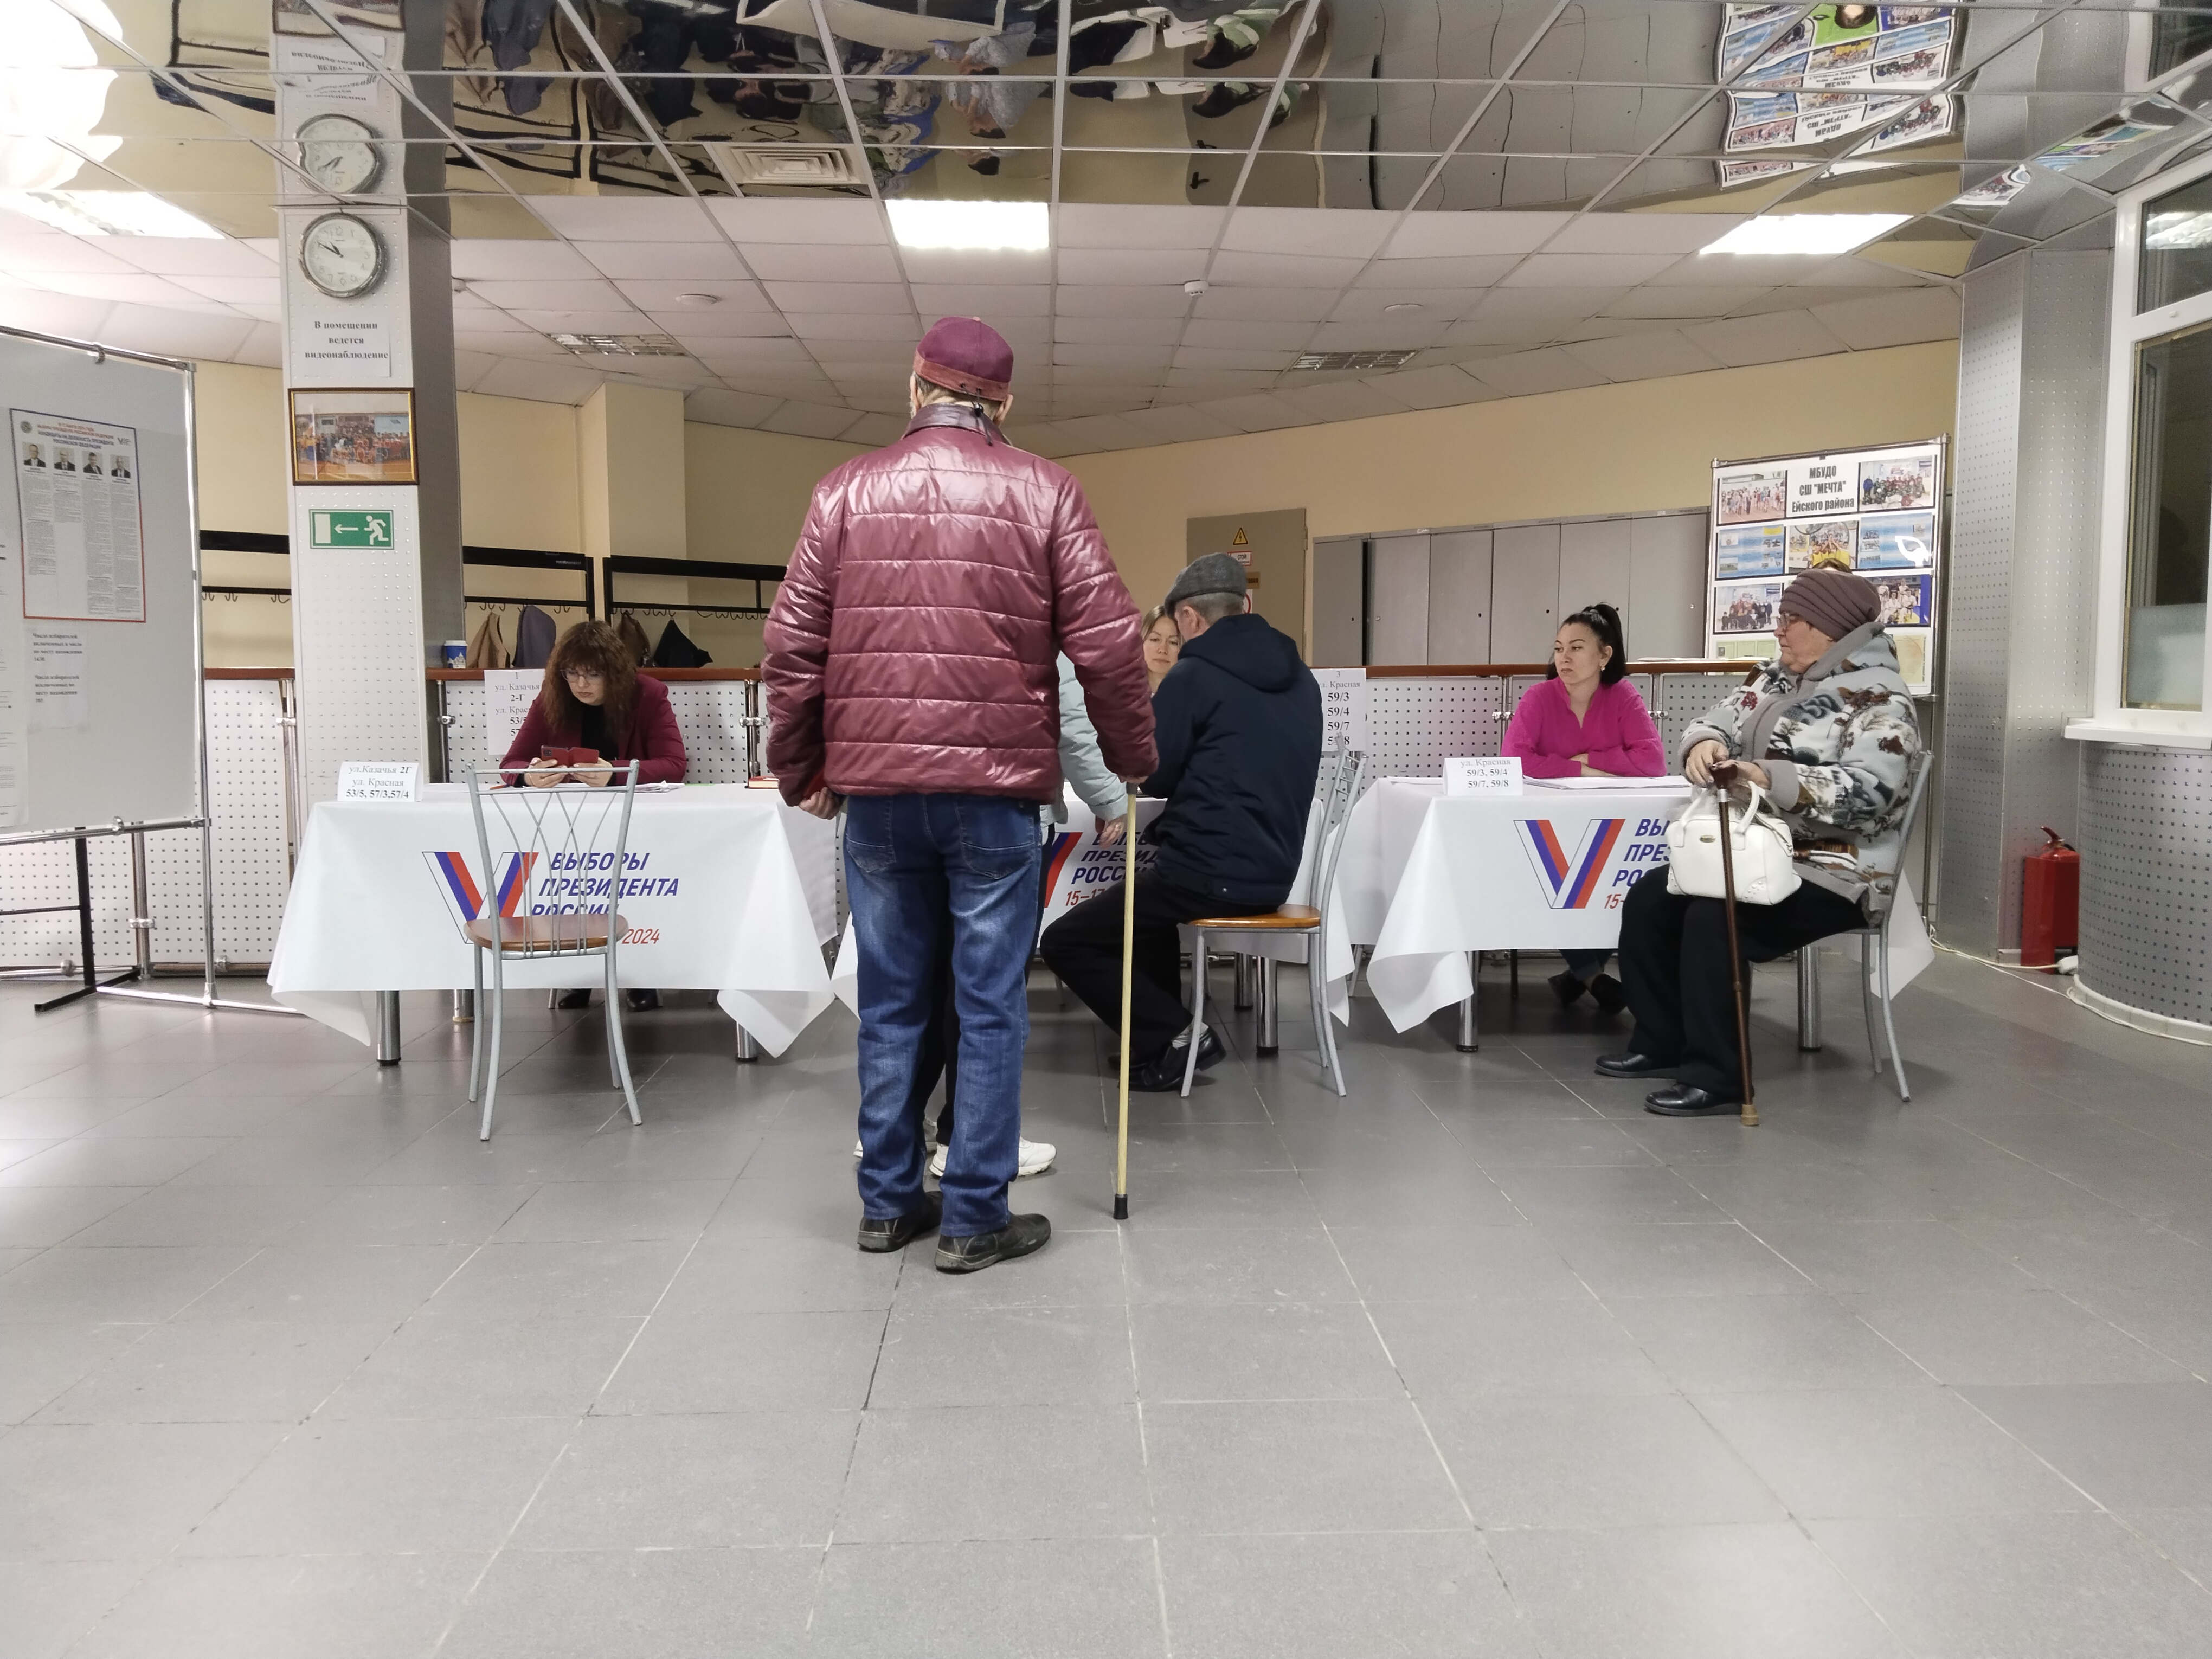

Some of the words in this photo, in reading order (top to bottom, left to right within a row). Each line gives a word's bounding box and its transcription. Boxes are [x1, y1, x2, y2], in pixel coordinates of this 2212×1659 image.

[305, 351, 388, 359] видеонаблюдение
[1809, 465, 1837, 479] МБУДО
[1799, 484, 1812, 496] СШ
[1814, 480, 1847, 494] "МЕЧТА"
[1792, 500, 1823, 512] Ейского
[1824, 497, 1855, 511] района
[1330, 681, 1360, 690] Красная
[1327, 692, 1349, 702] 59/3
[510, 706, 530, 715] Крас
[1327, 706, 1349, 716] 59/4
[1327, 721, 1350, 731] 59/7
[1476, 759, 1511, 767] Красная
[1467, 769, 1488, 777] 59/3,
[368, 778, 404, 787] Красная
[1468, 780, 1489, 788] 59/7,
[346, 789, 367, 799] 53/5,
[538, 878, 679, 898] ПРЕЗИДЕНТА
[622, 929, 660, 944] 2024
